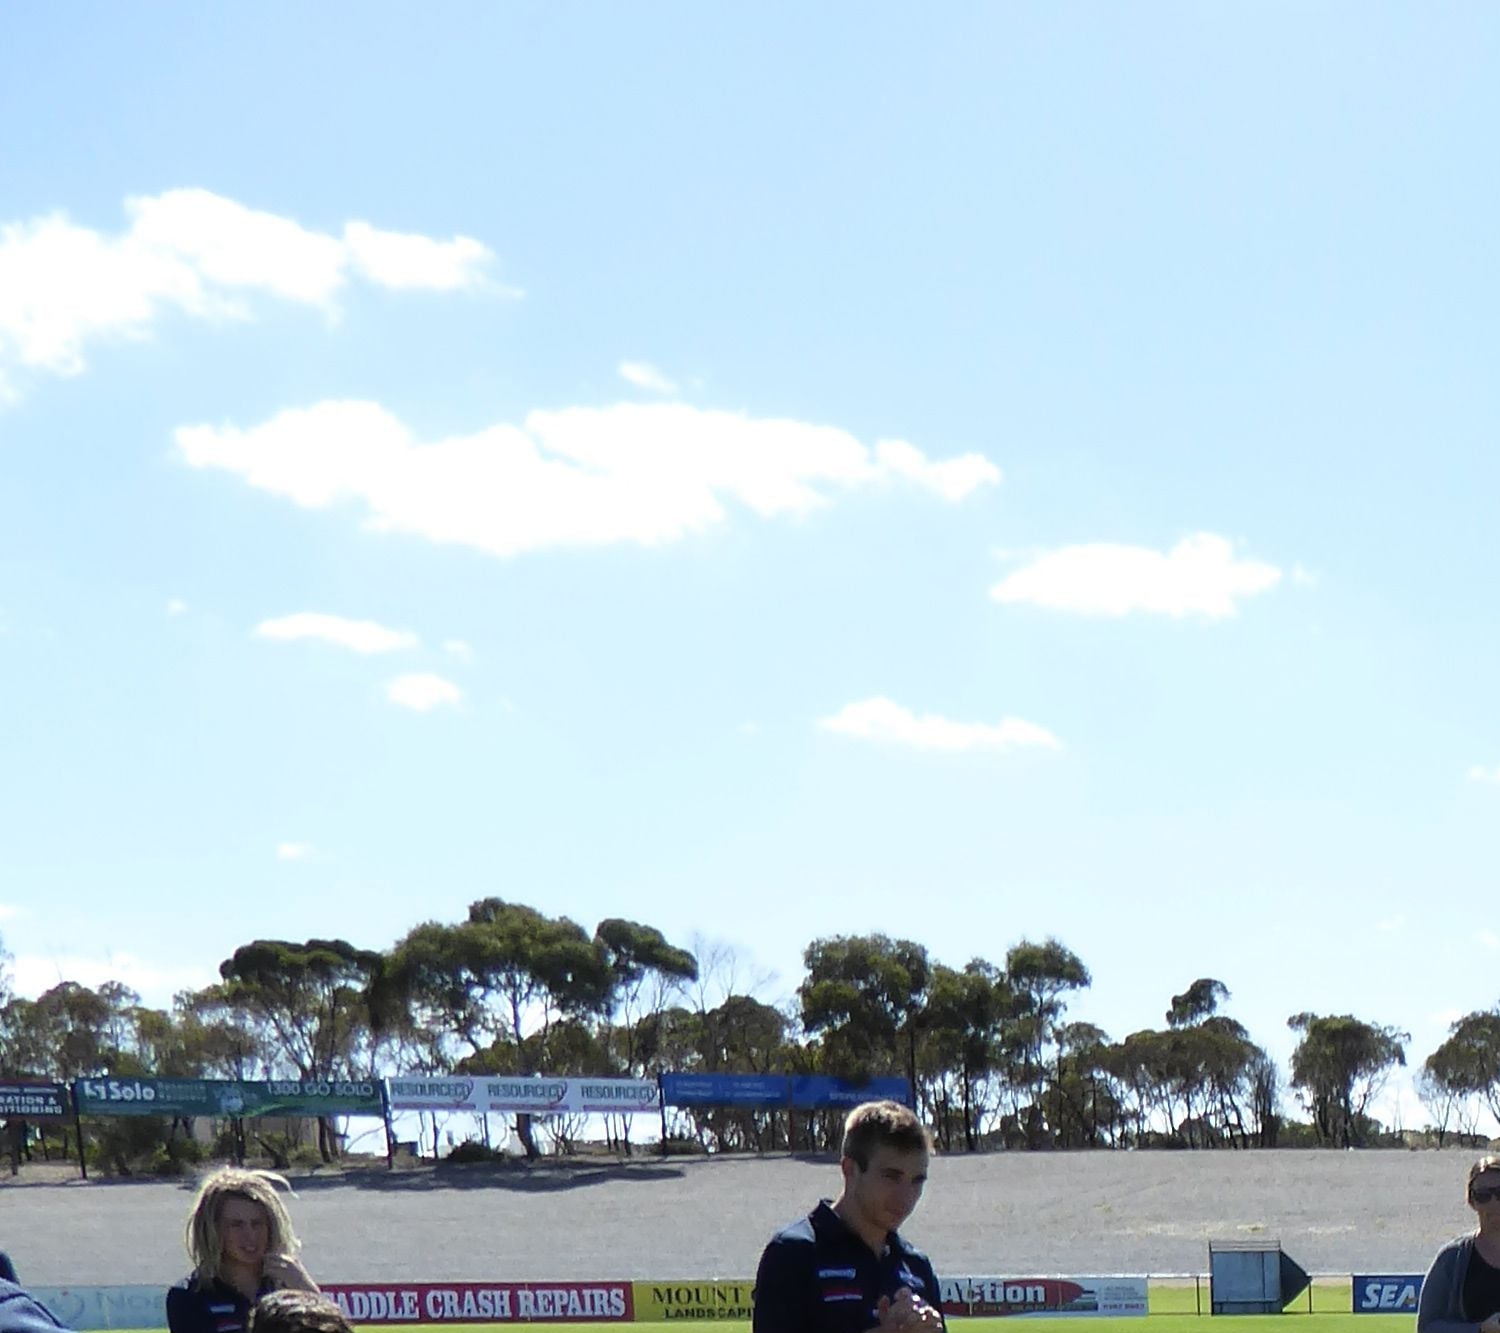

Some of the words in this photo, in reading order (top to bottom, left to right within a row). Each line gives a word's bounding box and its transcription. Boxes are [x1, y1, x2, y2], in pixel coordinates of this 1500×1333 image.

[109, 1081, 155, 1101] Solo
[652, 1286, 745, 1305] MOUNT
[940, 1282, 1046, 1303] Action
[1361, 1283, 1416, 1308] SEA
[425, 1290, 512, 1318] CRASH
[516, 1288, 626, 1317] REPAIRS
[664, 1307, 753, 1319] LANDSCAPI
